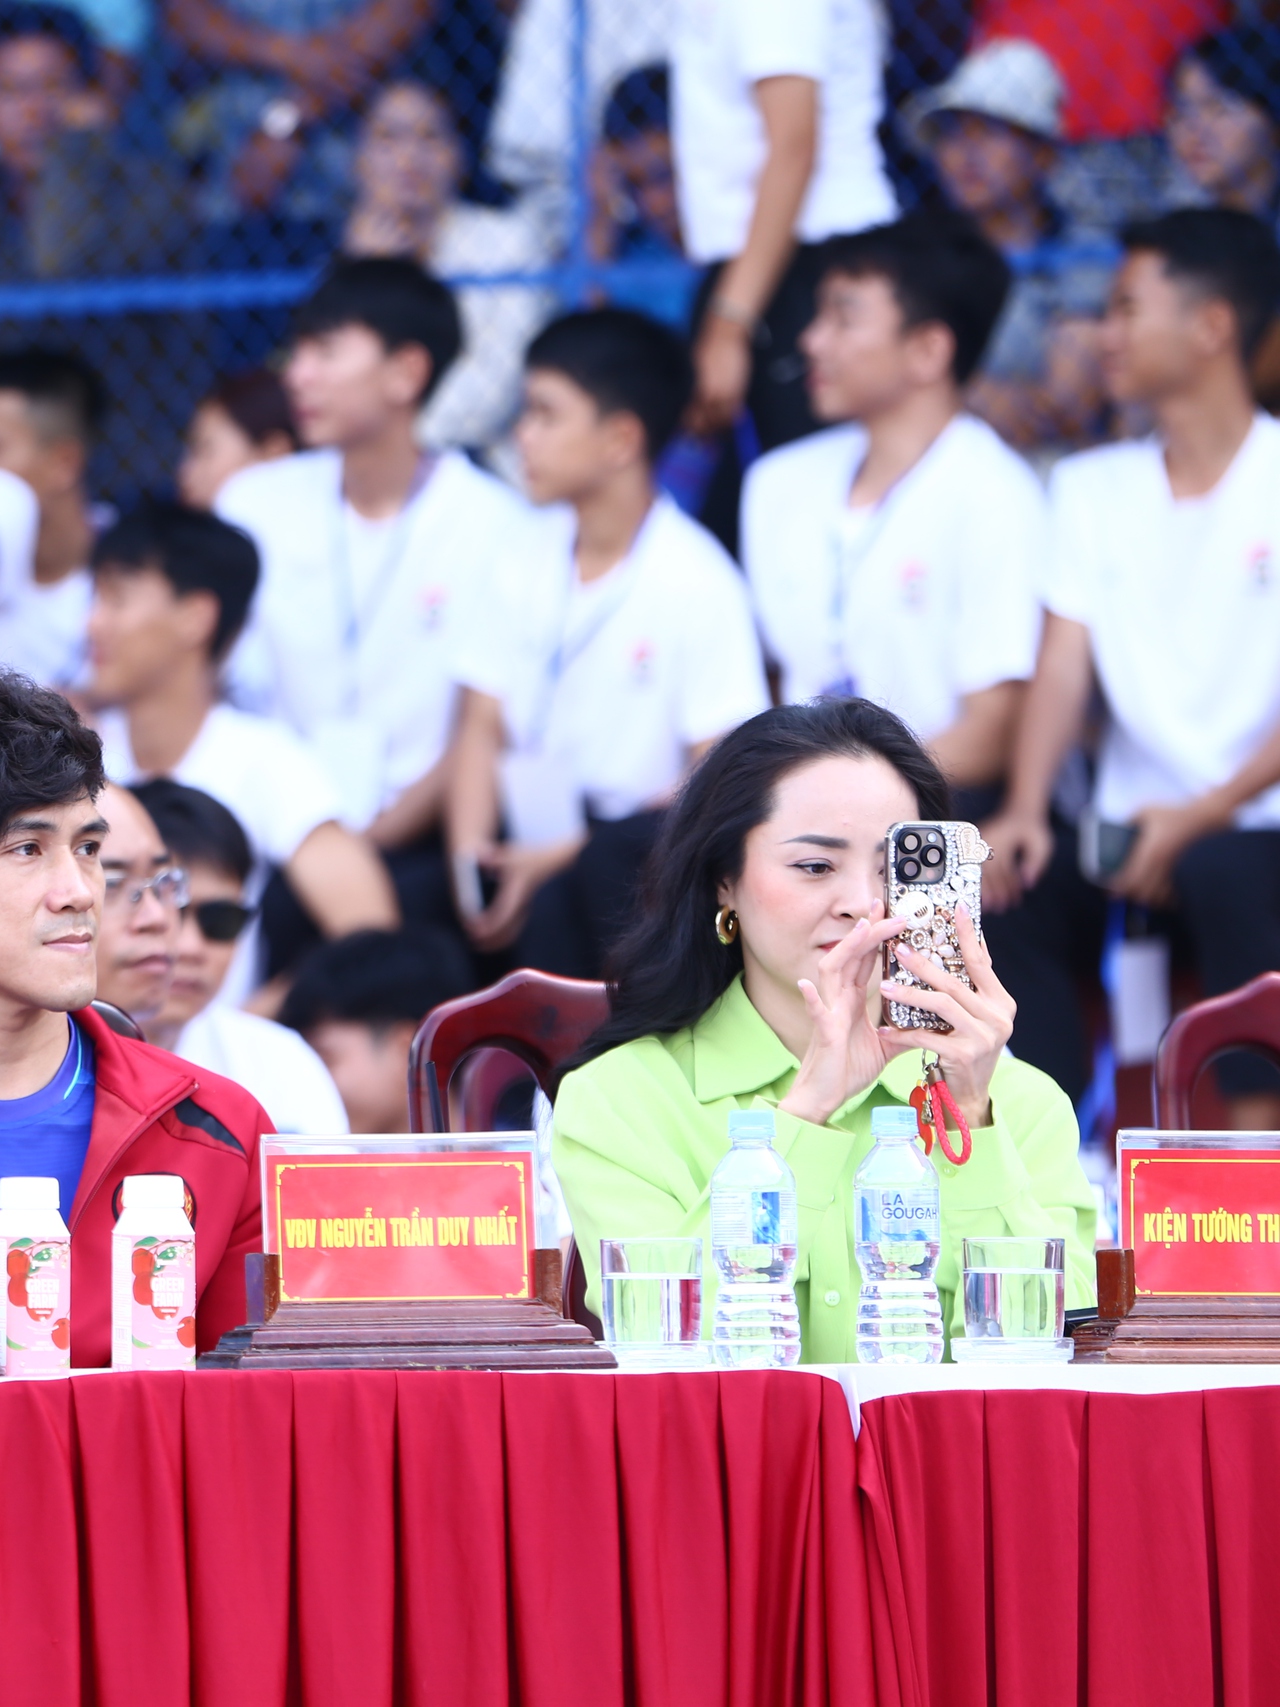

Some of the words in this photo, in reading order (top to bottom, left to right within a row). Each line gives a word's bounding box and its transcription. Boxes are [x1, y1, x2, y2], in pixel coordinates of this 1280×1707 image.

[881, 1193, 904, 1206] LA
[284, 1219, 317, 1248] VĐV
[320, 1207, 386, 1248] NGUYỄN
[389, 1207, 434, 1247] TRẦN
[437, 1216, 470, 1246] DUY
[473, 1206, 518, 1246] NHẤT
[1143, 1207, 1187, 1248] KIỆN
[1192, 1207, 1252, 1243] TƯỚNG
[26, 1278, 60, 1294] GREEN
[150, 1277, 185, 1293] GREEN
[28, 1294, 59, 1309] FARM
[152, 1293, 183, 1308] FARM
